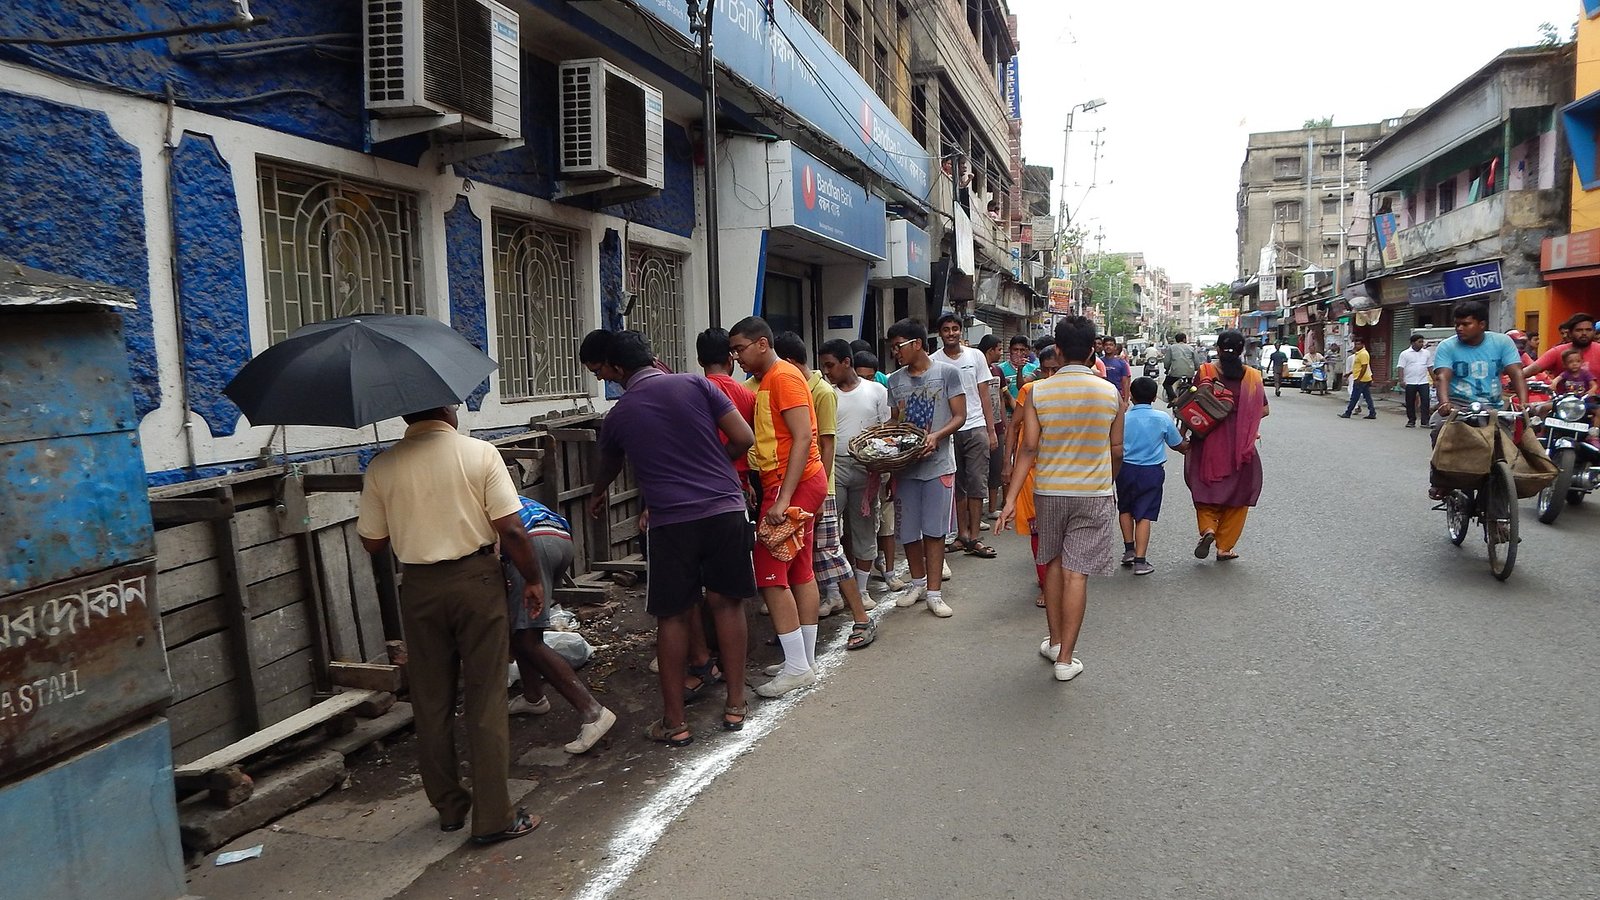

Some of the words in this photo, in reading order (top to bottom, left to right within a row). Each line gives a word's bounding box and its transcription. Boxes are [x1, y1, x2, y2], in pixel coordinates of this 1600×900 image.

[728, 0, 763, 45] Bank
[873, 116, 897, 161] Bandhan
[816, 172, 840, 202] Bandhan
[840, 187, 854, 209] Bank
[1463, 269, 1500, 289] আঁচল
[18, 669, 86, 713] STALL
